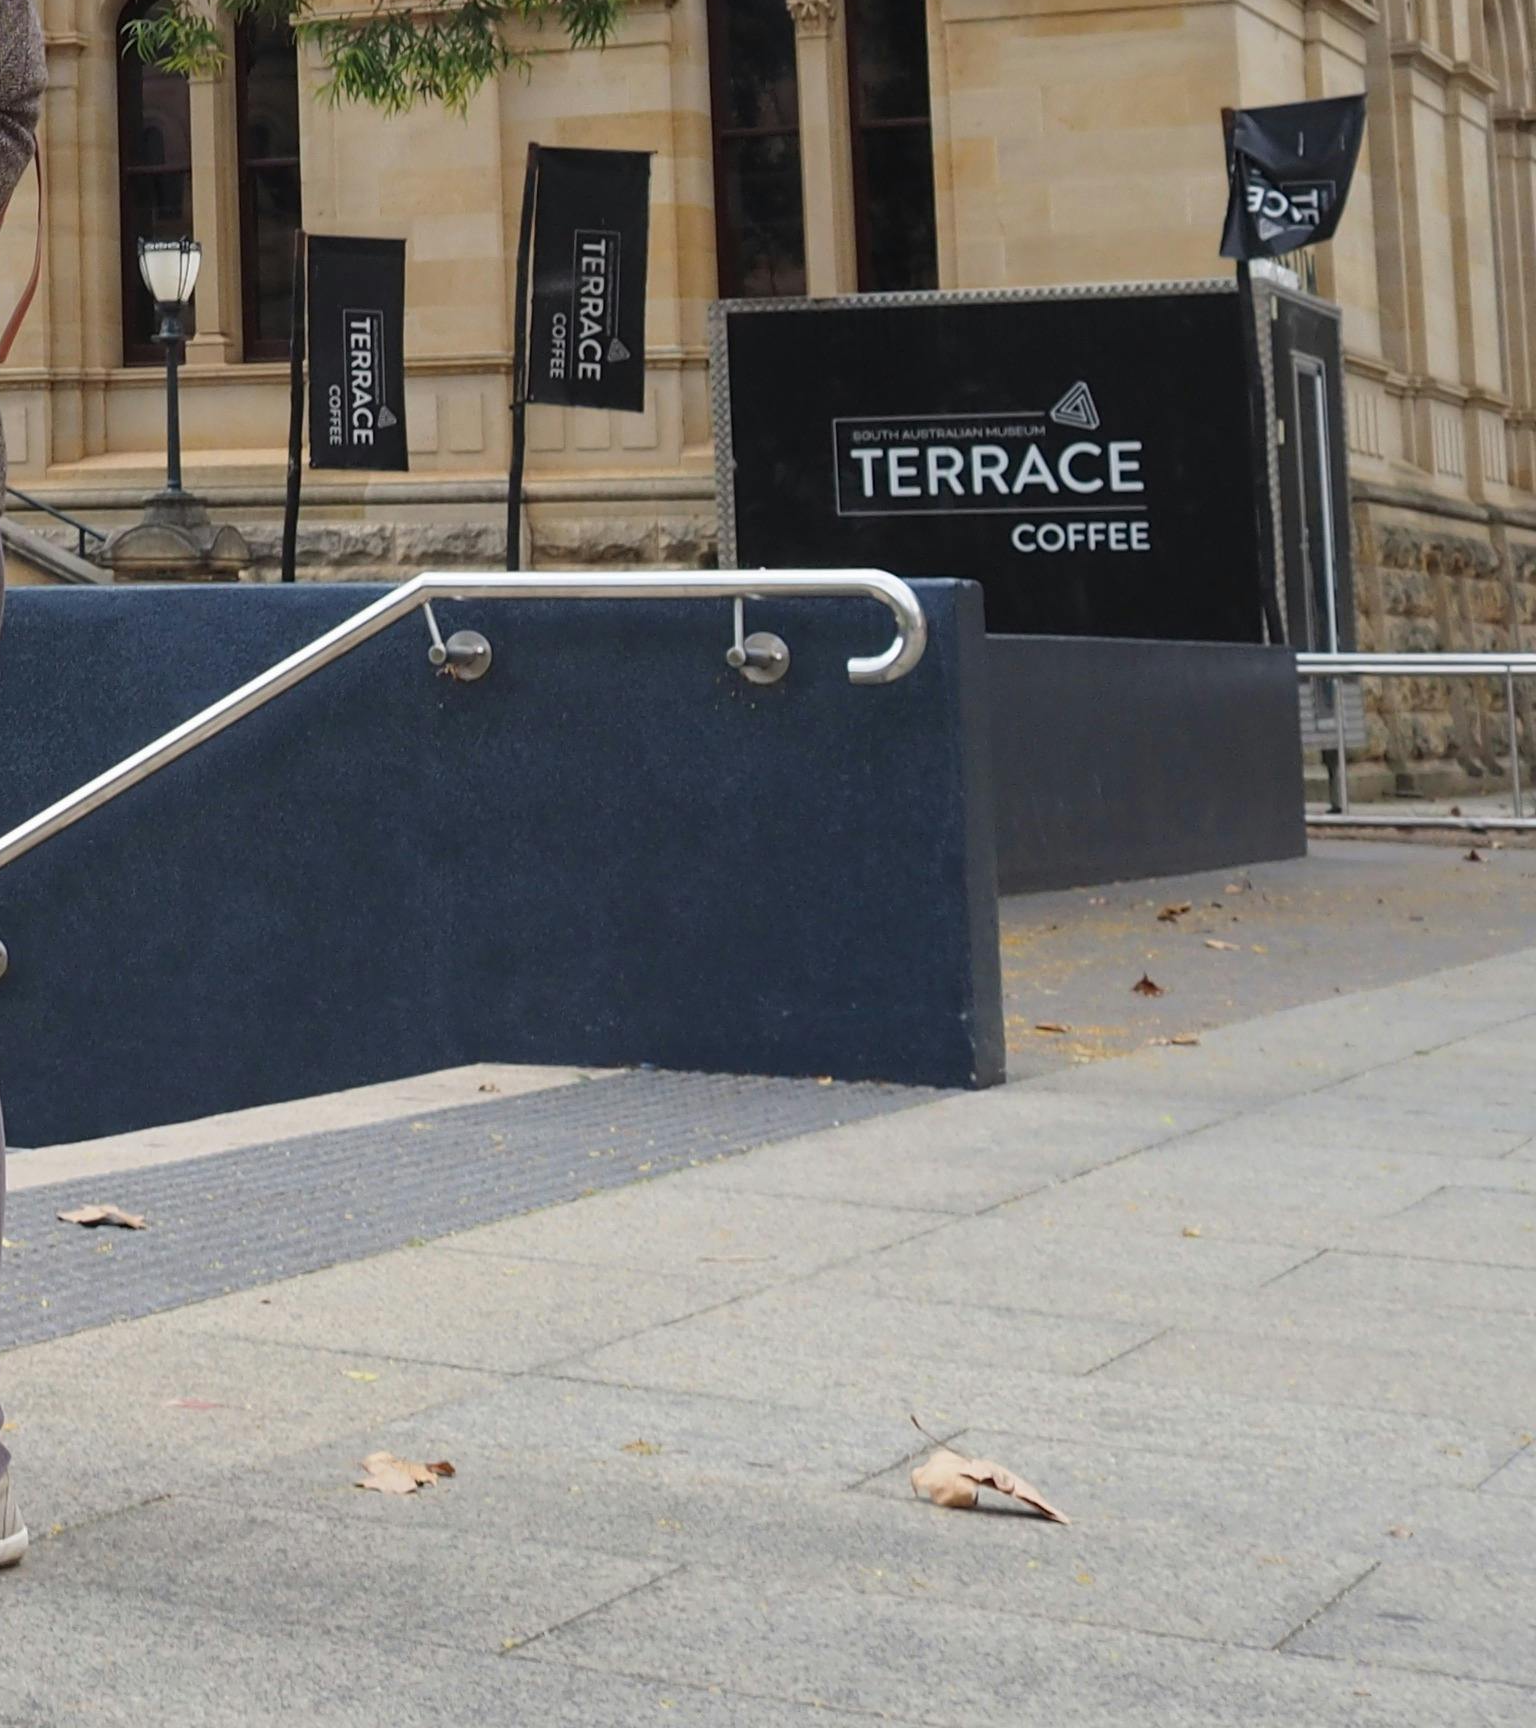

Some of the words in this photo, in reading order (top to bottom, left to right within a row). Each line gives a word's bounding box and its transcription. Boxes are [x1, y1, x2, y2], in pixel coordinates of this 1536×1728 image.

[578, 238, 606, 381] TERRACE
[550, 312, 566, 379] COFFEE
[350, 316, 374, 446] TERRACE
[328, 384, 342, 445] COFFEE
[852, 429, 900, 442] SOUTH
[902, 426, 983, 440] AUSTRALIAN
[985, 424, 1046, 438] MUSEUM
[850, 440, 1145, 498] TERRACE
[1011, 522, 1151, 552] COFFEE
